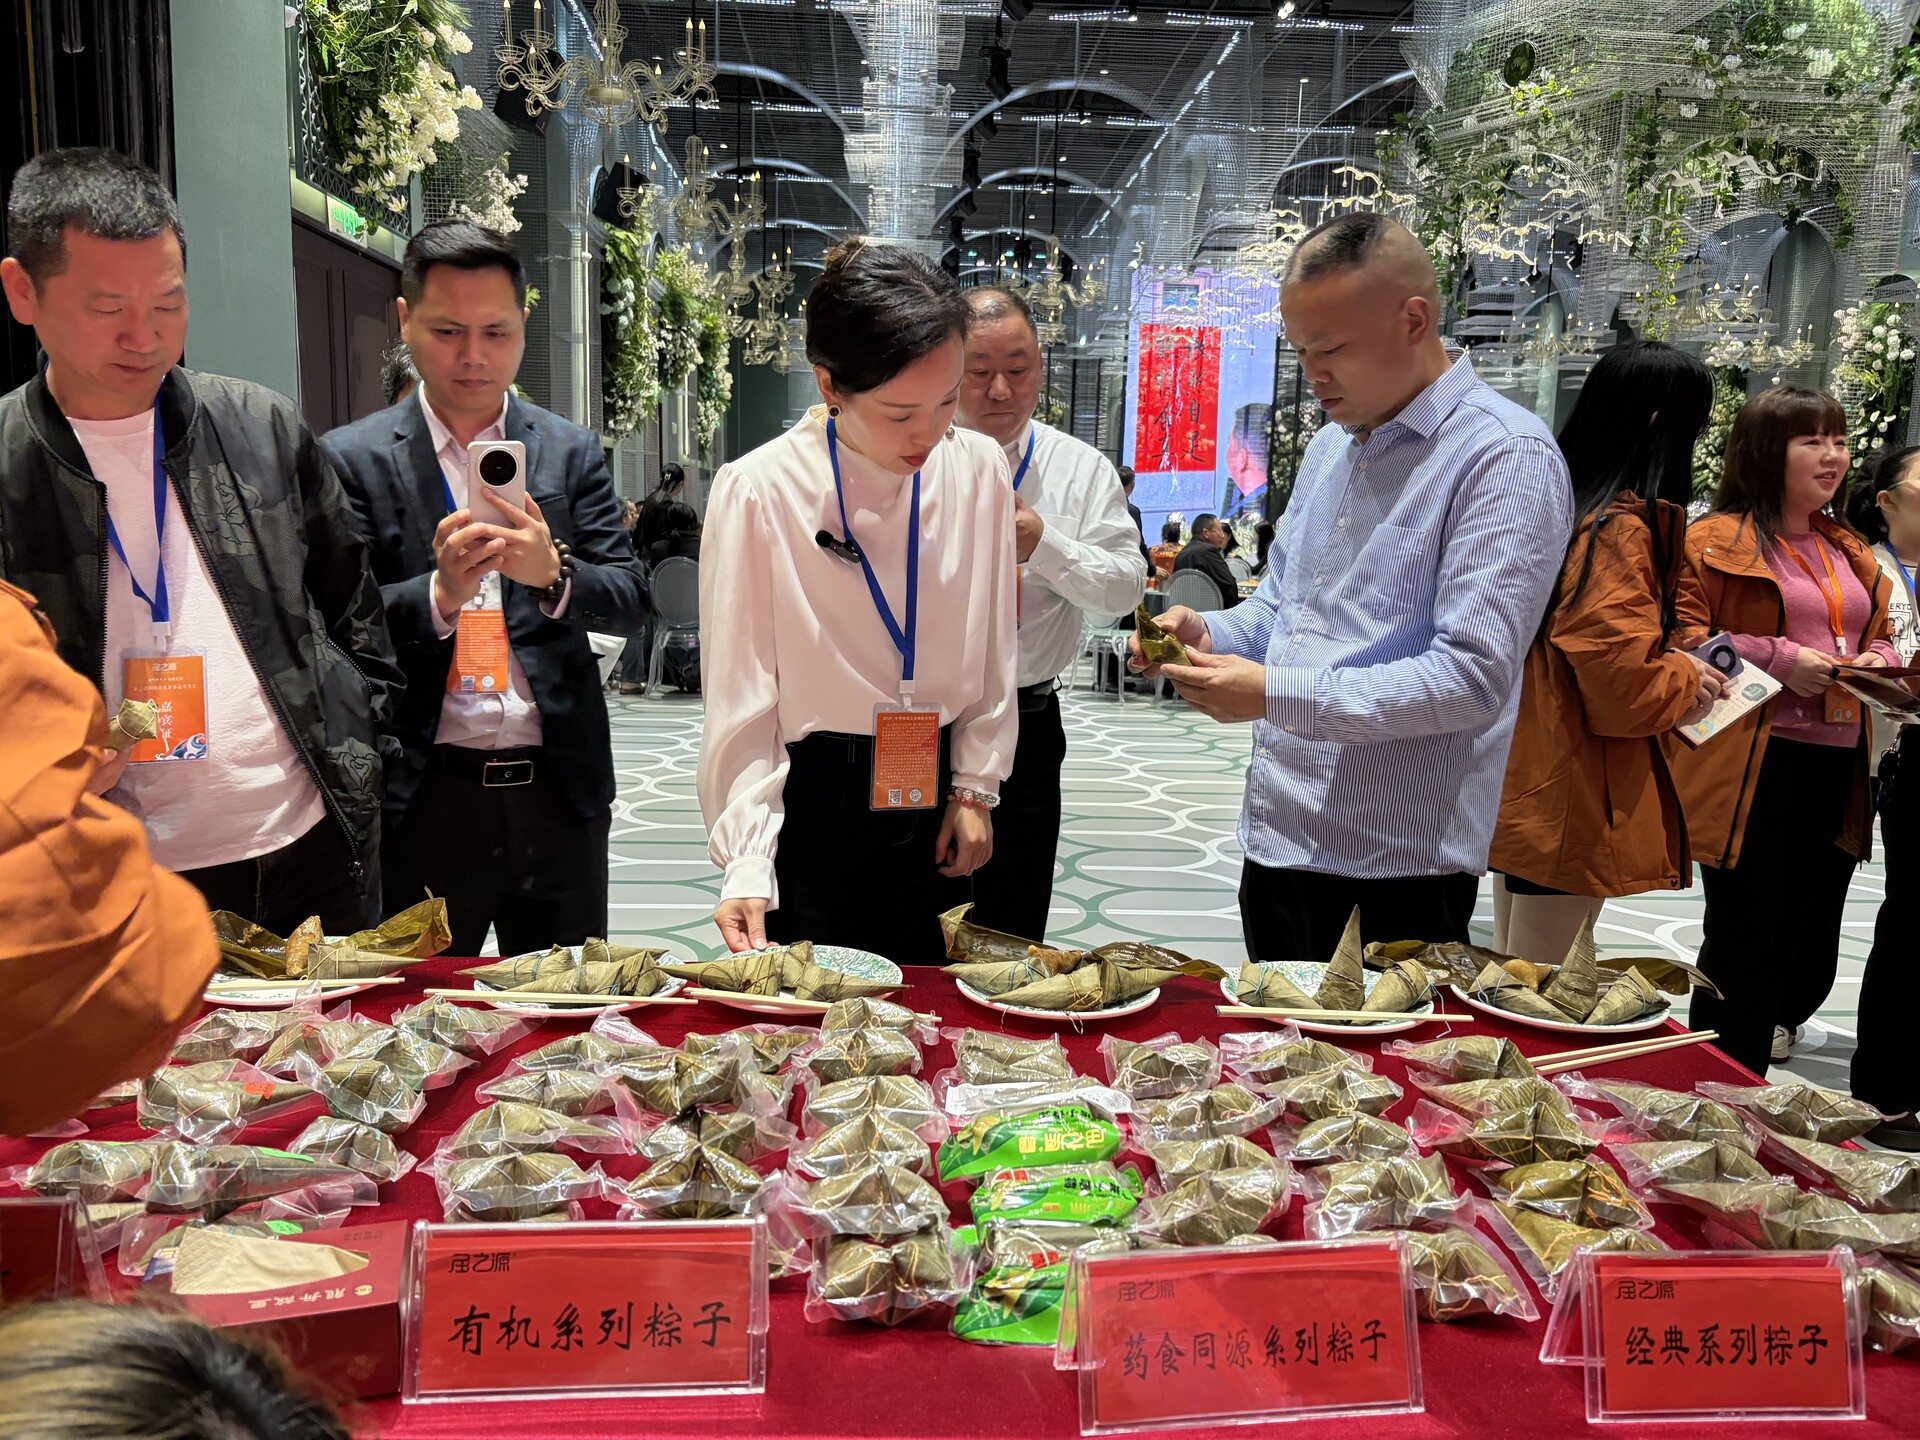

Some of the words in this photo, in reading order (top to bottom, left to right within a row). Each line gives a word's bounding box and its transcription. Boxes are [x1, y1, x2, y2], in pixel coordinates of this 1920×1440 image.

[448, 1301, 732, 1356] 有机系列粽子
[1122, 1319, 1387, 1381] 药食同源系列粽子
[1625, 1323, 1829, 1367] 经典系列粽子
